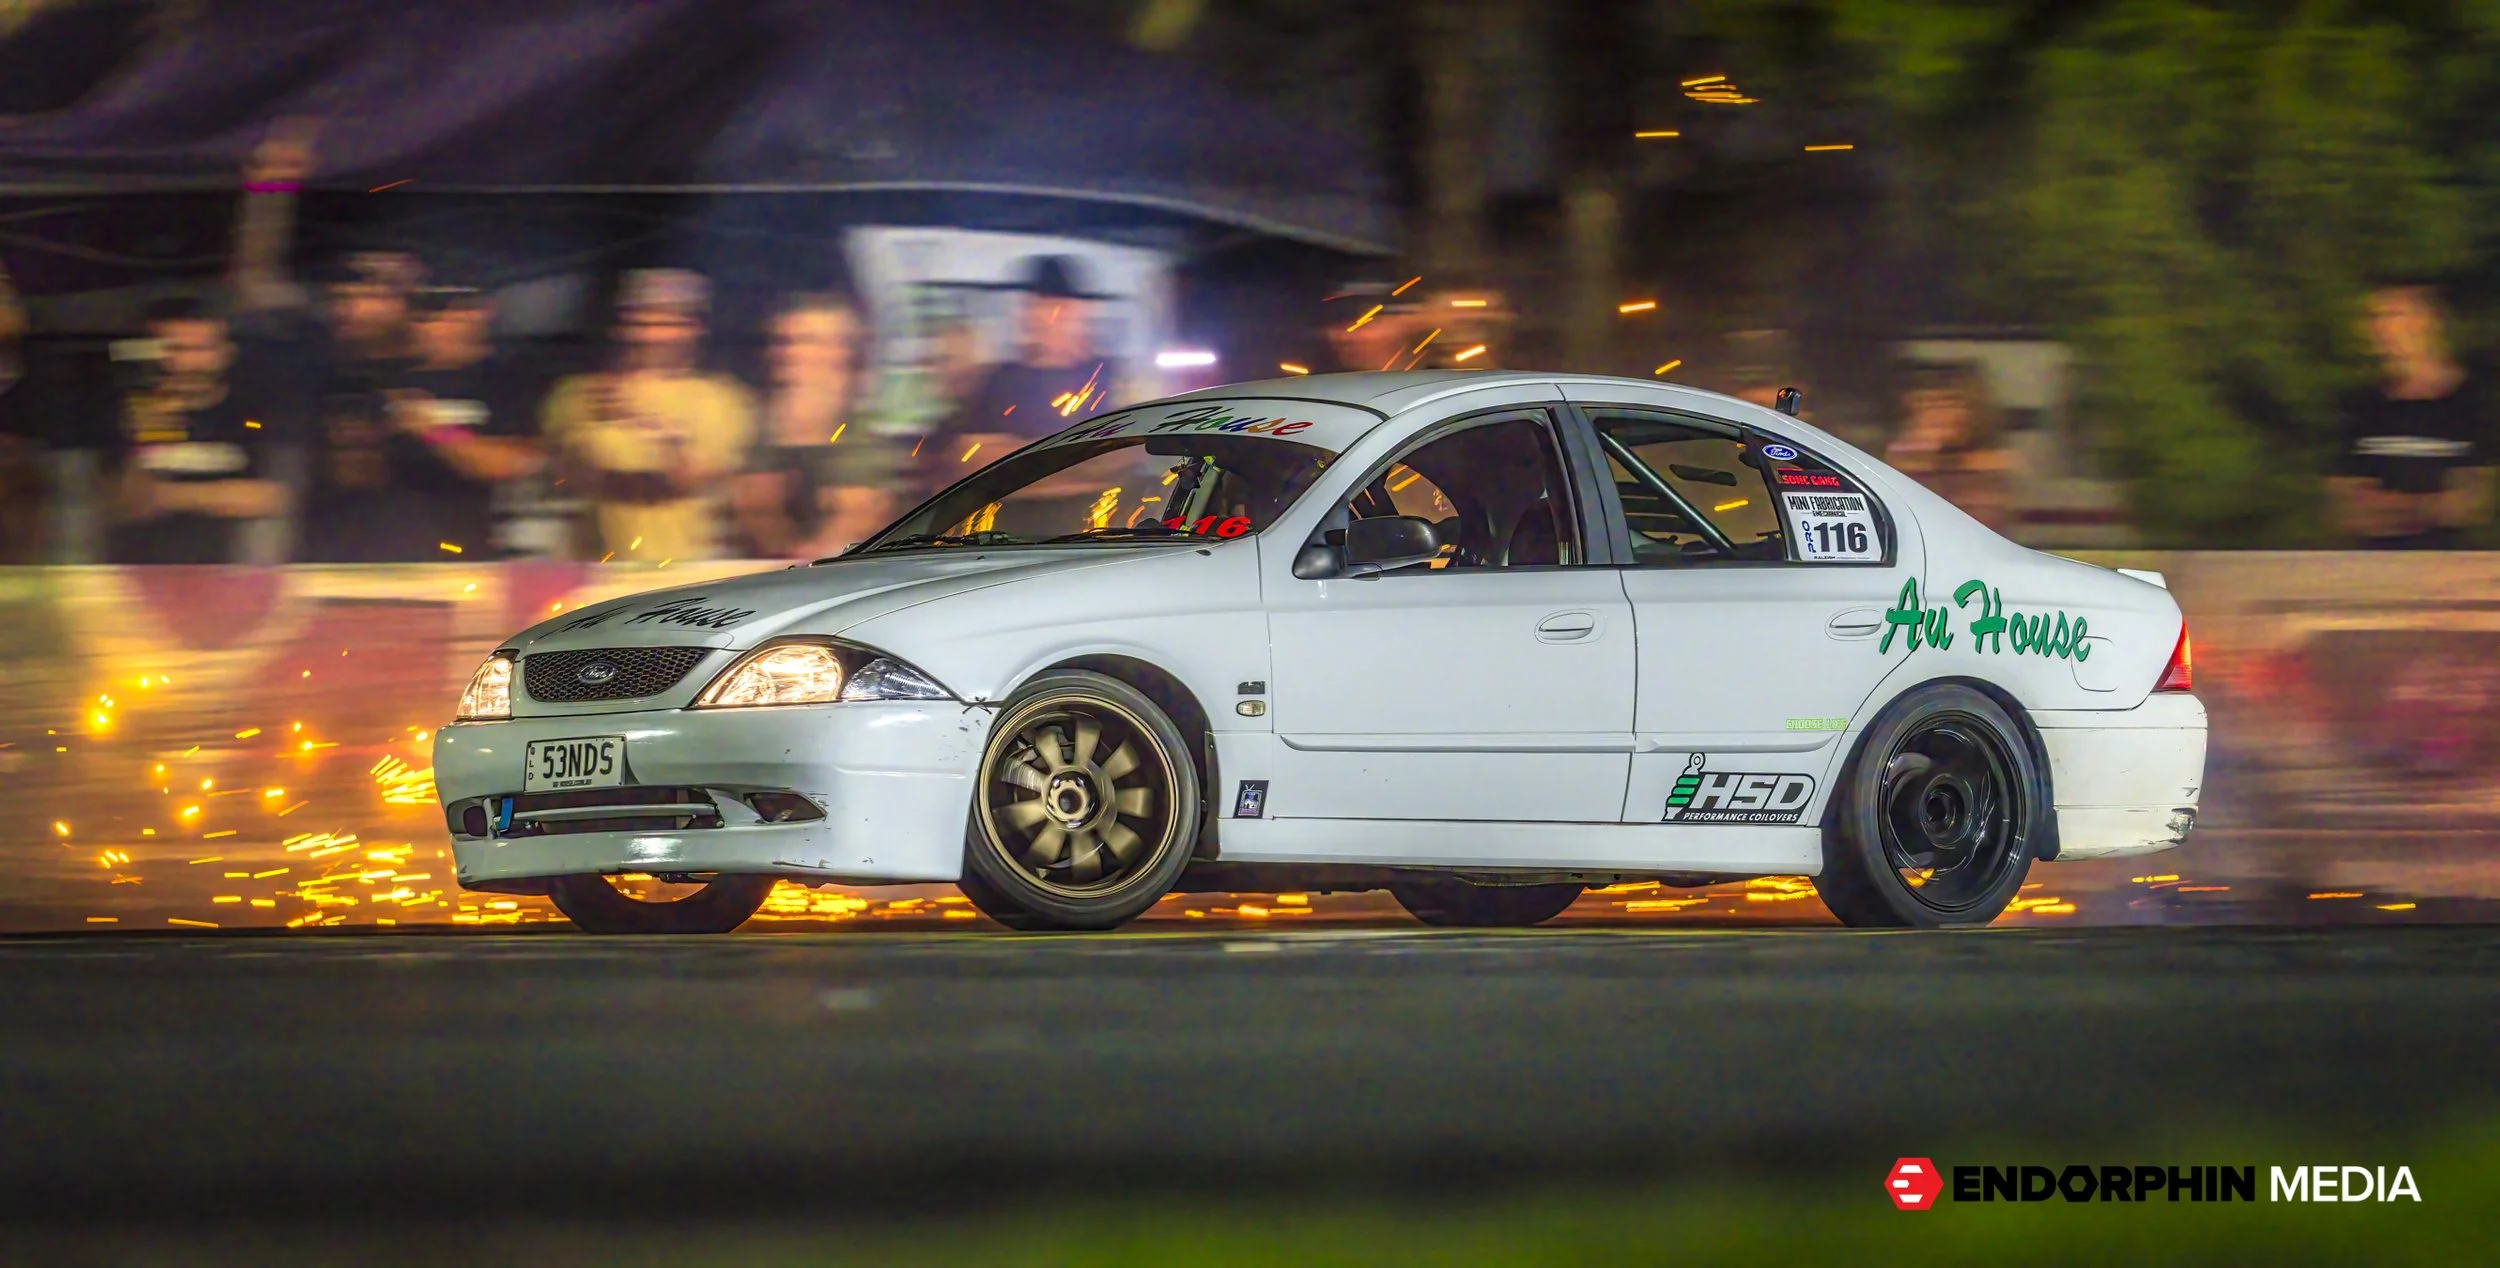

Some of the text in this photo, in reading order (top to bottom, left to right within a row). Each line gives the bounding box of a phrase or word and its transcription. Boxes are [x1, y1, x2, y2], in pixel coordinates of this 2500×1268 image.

[1148, 405, 1313, 436] House
[1787, 496, 1865, 511] MINI FABRICATION
[1162, 515, 1251, 538] 116
[1801, 520, 1817, 553] PRO
[1813, 522, 1868, 553] 116
[1879, 576, 2091, 662] Au House
[543, 741, 614, 779] 53NDS
[1688, 774, 1815, 810] HSD
[1683, 812, 1799, 822] PERFORMANCE COILOVERS
